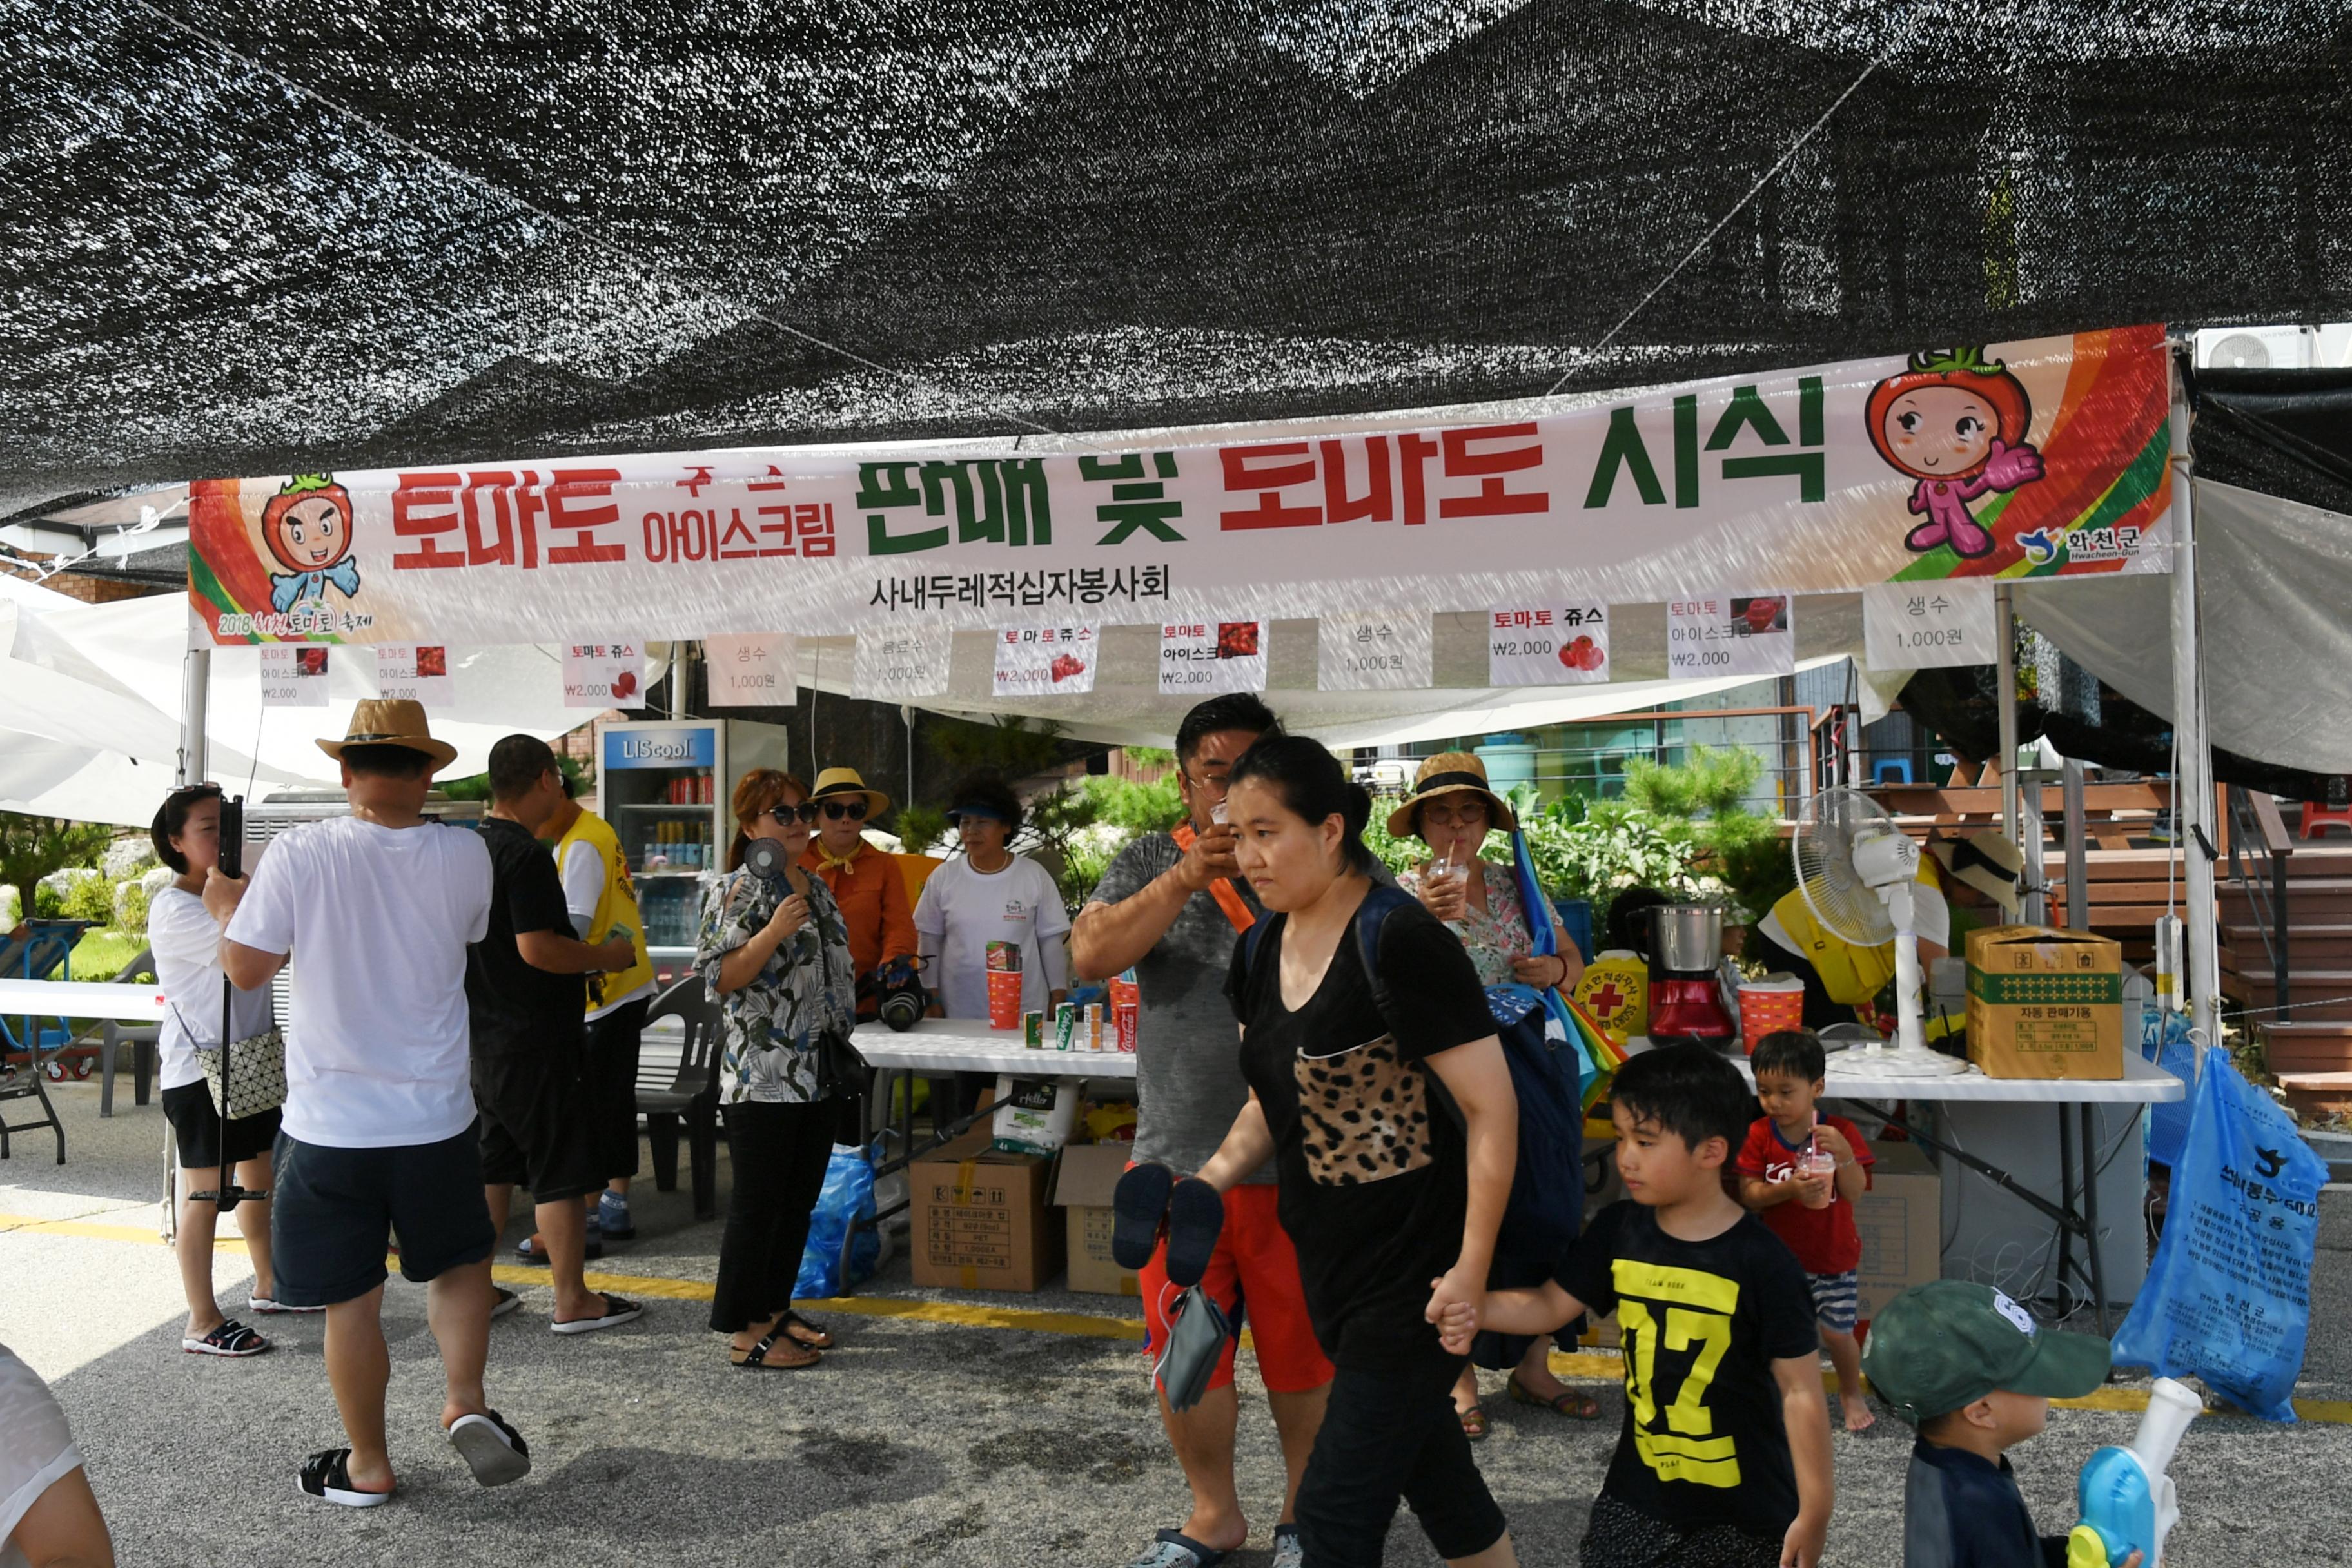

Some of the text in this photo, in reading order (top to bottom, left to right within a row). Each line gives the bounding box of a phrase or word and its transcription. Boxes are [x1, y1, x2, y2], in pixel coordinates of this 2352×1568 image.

[391, 375, 1825, 569] 토마토 아이스크림 판매 및 토마토 시식
[2068, 527, 2139, 551] 화천군
[2072, 549, 2139, 560] Hwacheon-Gun
[870, 564, 1170, 611] 사내두레적십자봉사회
[1671, 600, 1718, 616] 토마토
[1906, 594, 1950, 616] 생수
[220, 616, 250, 633] 2018
[290, 613, 333, 633] 토마토
[340, 611, 372, 632] 축제
[1494, 607, 1604, 627] 토마토 쥬스
[1164, 625, 1205, 638] 토마토
[1356, 624, 1393, 642] 생수
[1897, 630, 1963, 648] 1,000원
[262, 649, 289, 660] 토마토
[378, 648, 407, 659] 토마토
[572, 645, 634, 658] 토마토 쥬스
[736, 645, 766, 662] 생수
[1163, 646, 1233, 662] 아이스크
[1346, 655, 1403, 672] 1,000원
[379, 667, 429, 678] 아이스크
[730, 675, 776, 689] 1,000원
[623, 739, 690, 759] LIScool
[2021, 1006, 2091, 1019] 자동 판매기용
